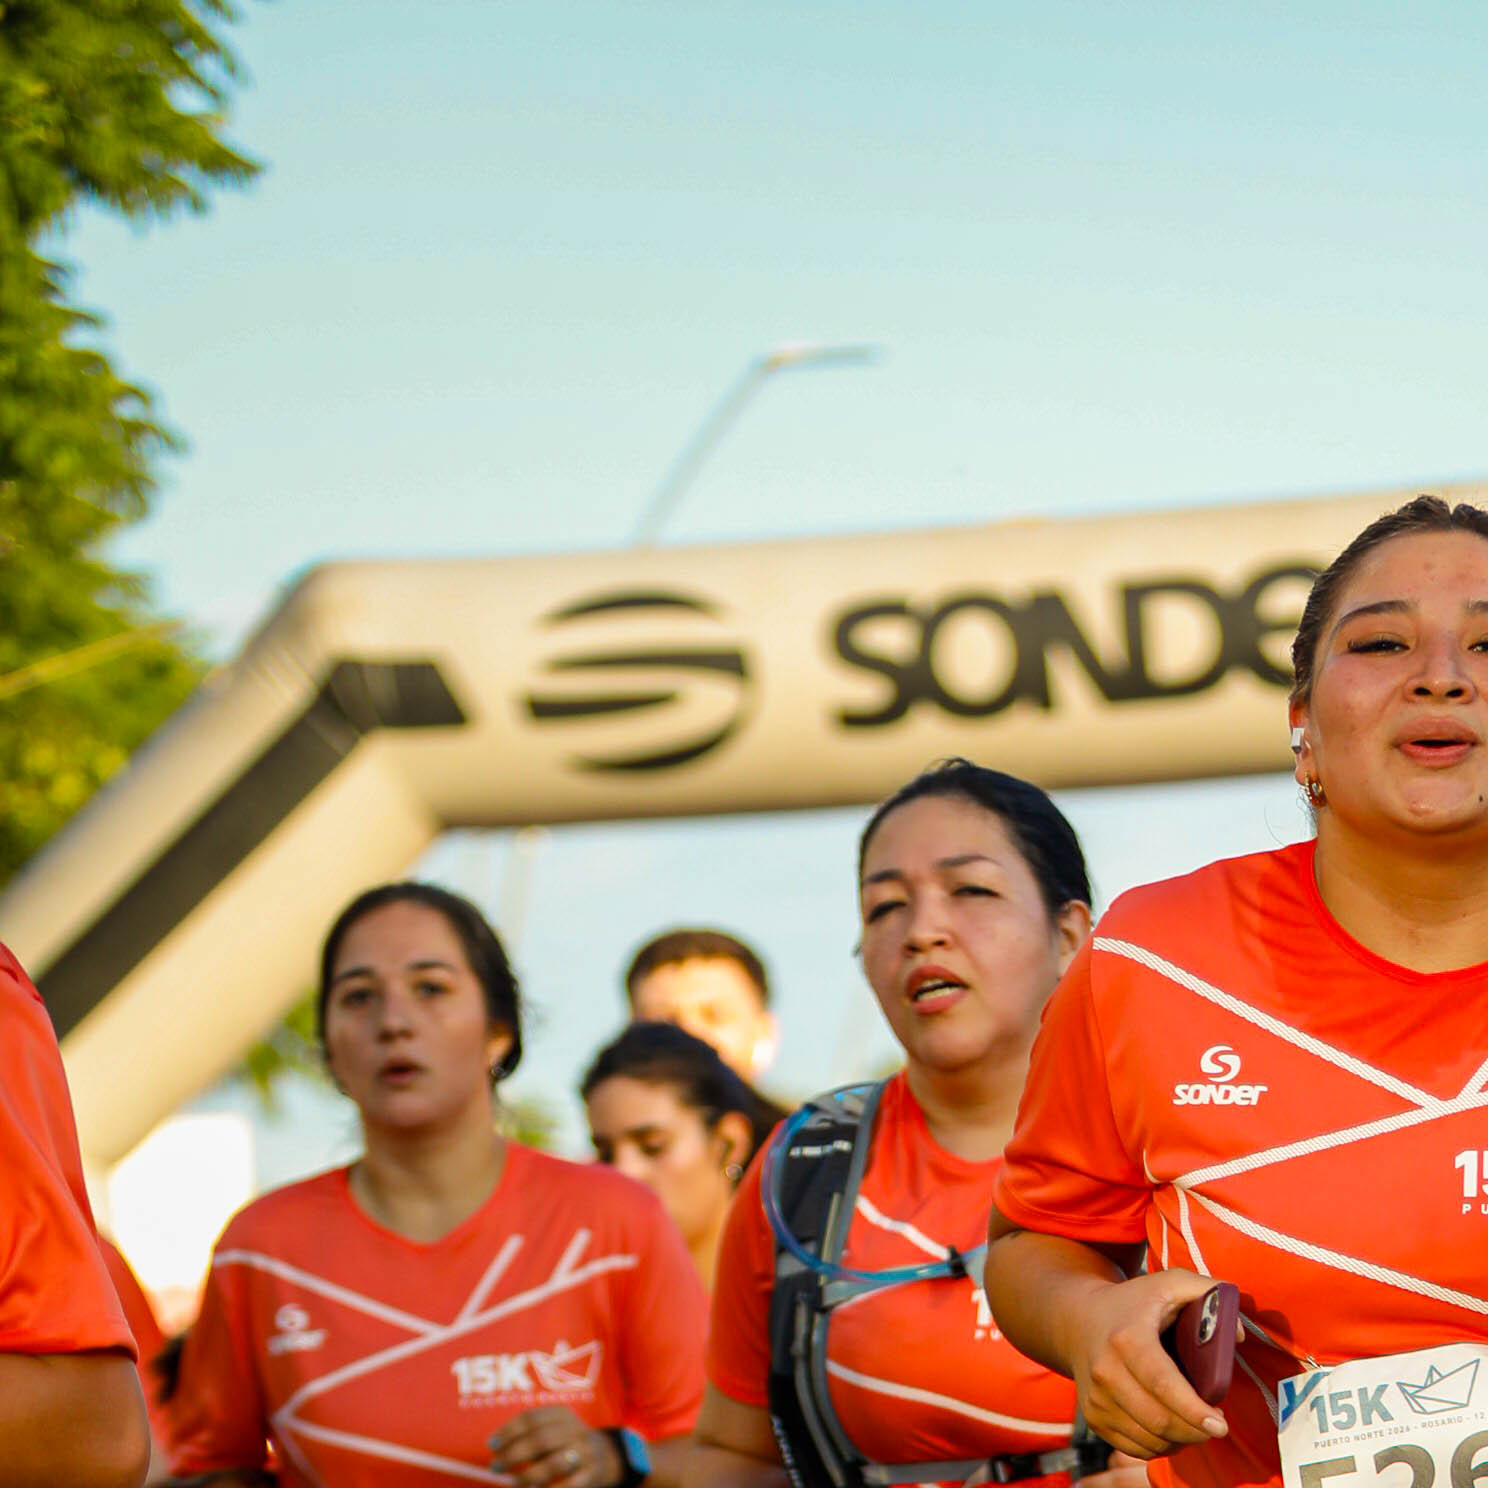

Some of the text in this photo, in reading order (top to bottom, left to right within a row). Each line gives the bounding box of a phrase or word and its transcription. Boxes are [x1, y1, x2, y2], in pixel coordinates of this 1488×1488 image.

[450, 1353, 533, 1396] 15K
[1309, 1382, 1394, 1434] 15K
[1314, 1436, 1351, 1449] PUERTO
[1354, 1430, 1384, 1441] NORTE
[1421, 1415, 1463, 1428] ROSARIO
